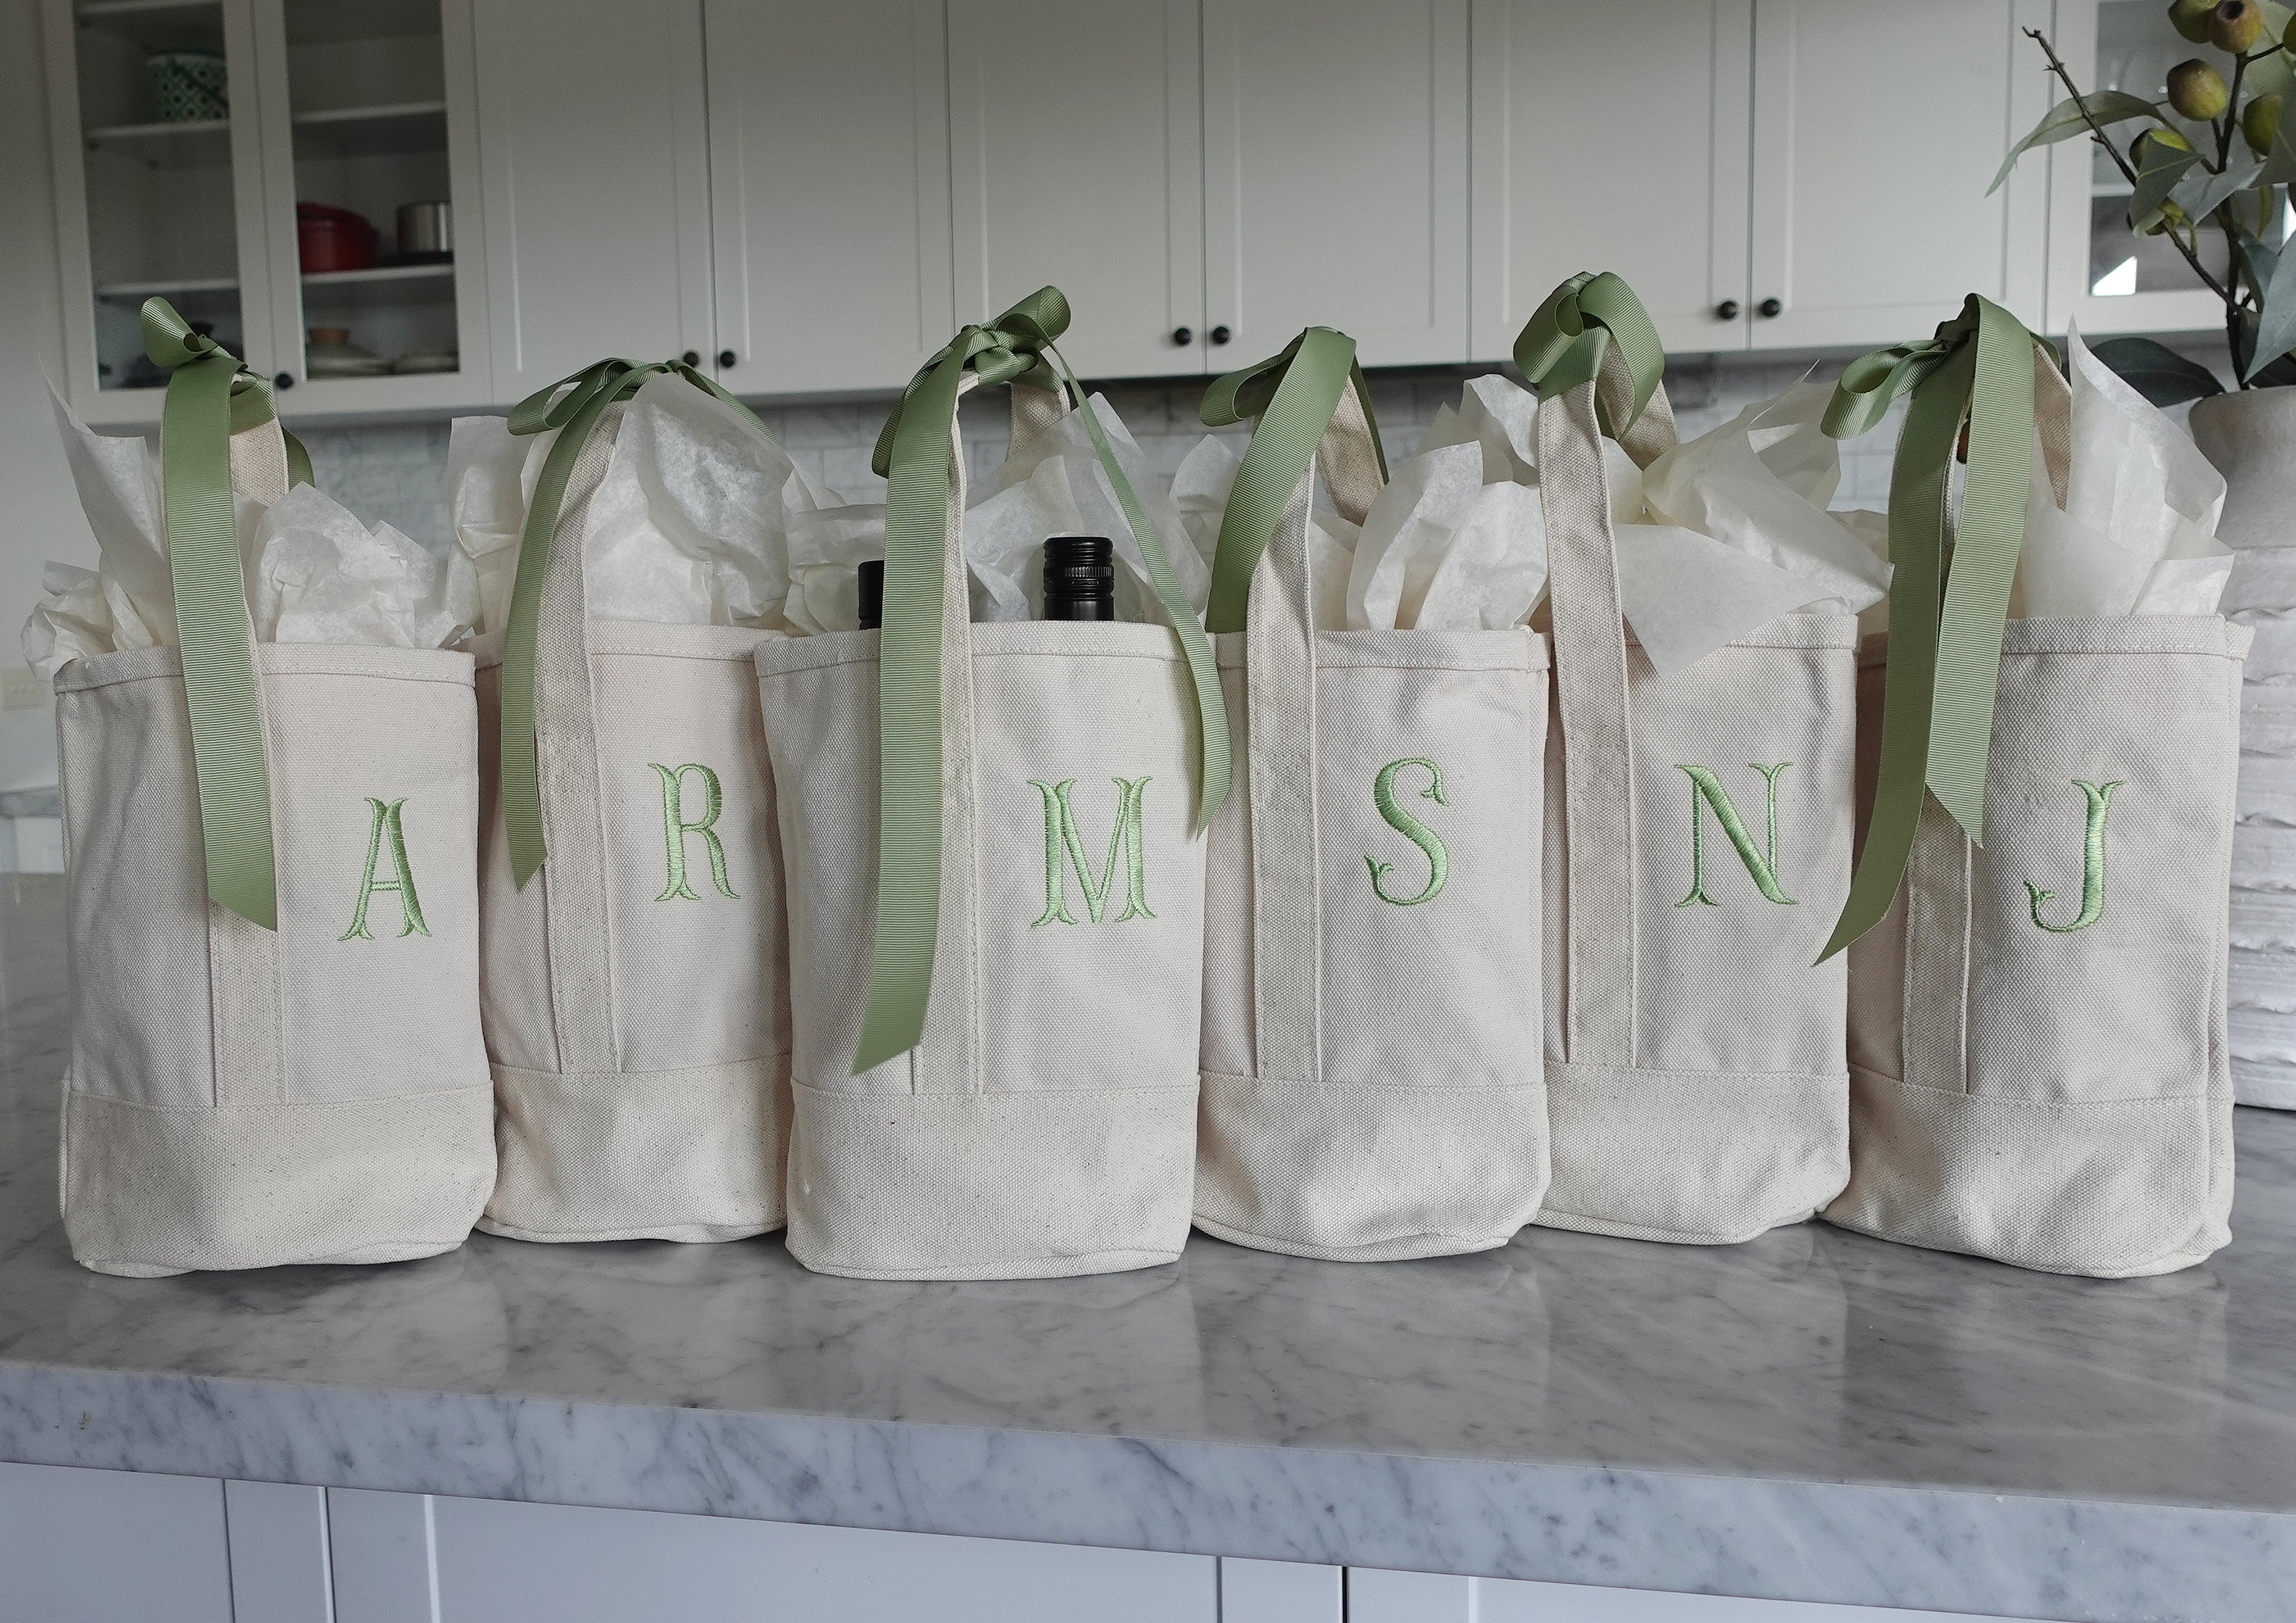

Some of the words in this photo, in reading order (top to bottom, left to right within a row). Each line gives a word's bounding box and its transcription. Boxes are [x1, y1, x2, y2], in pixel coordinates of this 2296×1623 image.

[337, 796, 432, 941] A
[648, 763, 741, 903] R
[1027, 775, 1157, 928] M
[1364, 757, 1448, 907] S
[1674, 762, 1797, 909] N
[2023, 779, 2125, 933] J
